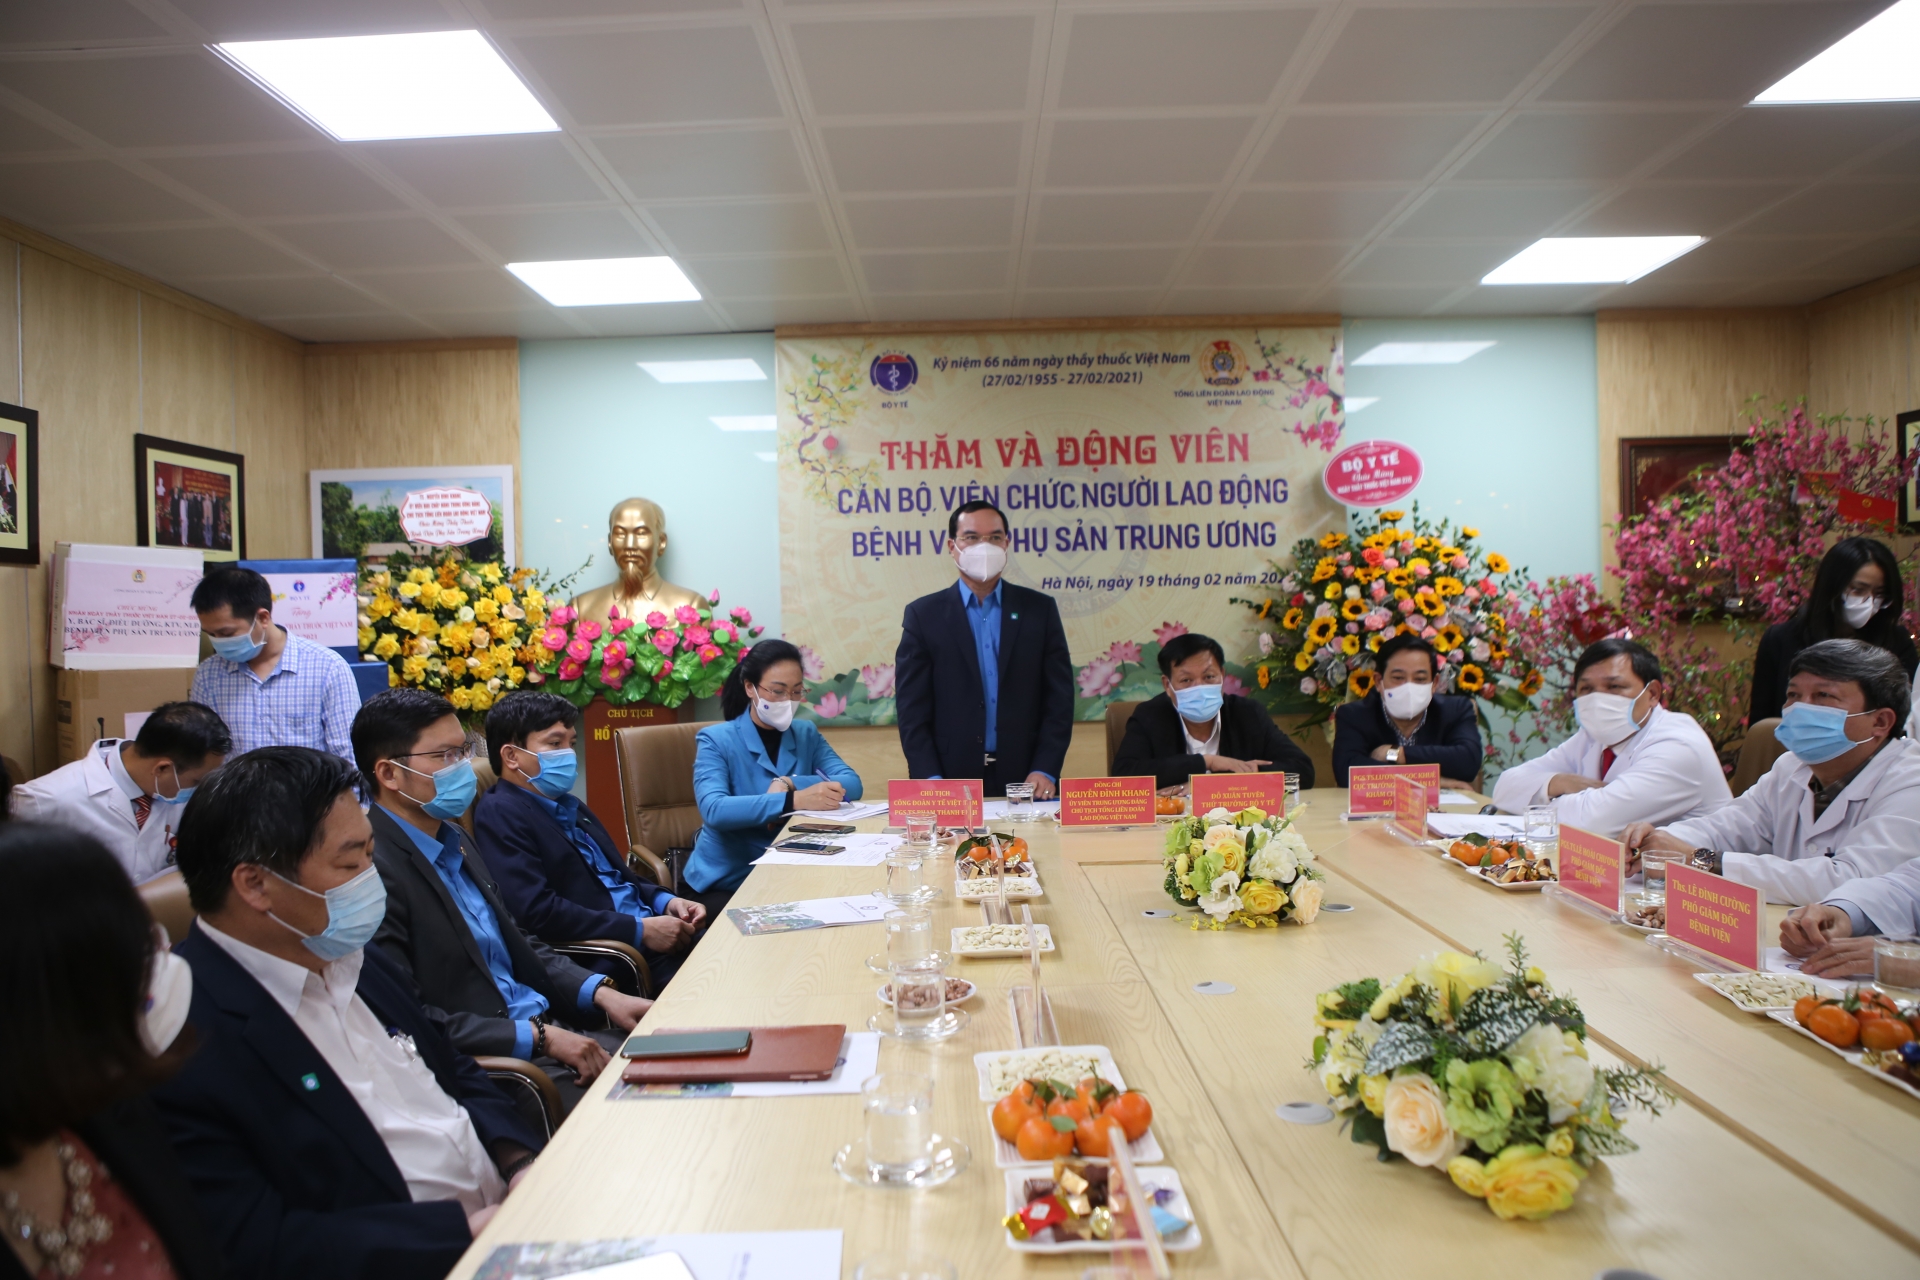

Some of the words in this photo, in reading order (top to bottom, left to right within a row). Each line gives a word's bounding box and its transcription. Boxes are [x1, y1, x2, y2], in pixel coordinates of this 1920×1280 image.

[933, 356, 948, 372] Kỷ
[951, 356, 981, 371] niệm
[984, 356, 1000, 368] 66
[1002, 355, 1030, 368] năm
[1032, 354, 1063, 370] ngày
[1097, 351, 1132, 366] thuốc
[1135, 352, 1159, 367] Việt
[1161, 352, 1191, 364] Nam
[982, 373, 1058, 388] (27/02/1955
[1067, 371, 1143, 386] 27/02/2021)
[1196, 389, 1212, 397] LIÊN
[1213, 388, 1235, 397] ĐOÀN
[1252, 388, 1275, 397] ĐỘNG
[881, 400, 892, 409] BỘ
[899, 400, 908, 408] TẾ
[1207, 399, 1223, 407] VIỆT
[880, 433, 983, 471] THĂM
[995, 430, 1044, 468] VÀ
[1056, 429, 1157, 473] ĐỘNG
[1170, 427, 1250, 464] VIÊN
[1341, 456, 1363, 473] BỘ
[1366, 455, 1377, 469] Y
[1380, 449, 1400, 467] TẾ
[838, 483, 891, 514] CÁN
[898, 481, 937, 517] BỘ,
[939, 480, 999, 511] VIÊN
[1006, 478, 1080, 510] CHỨC,
[1082, 475, 1159, 509] NGƯỜI
[1165, 480, 1213, 506] LAO
[1219, 474, 1289, 509] ĐỘNG
[852, 526, 922, 561] BỆNH
[1055, 519, 1107, 552] SẢN
[1115, 523, 1200, 551] TRUNG
[1207, 520, 1277, 548] ƯƠNG
[1041, 576, 1062, 590] Hà
[1065, 576, 1094, 593] Nội,
[1097, 574, 1134, 592] ngày
[1138, 575, 1155, 588] 19
[1158, 573, 1200, 589] tháng
[1204, 573, 1221, 586] 02
[1224, 572, 1256, 585] năm
[1259, 571, 1285, 585] 202
[77, 617, 96, 625] BÁC
[112, 628, 128, 637] PHỤ
[149, 629, 177, 637] TRUNG
[607, 706, 627, 718] CHỦ
[630, 708, 654, 719] TỊCH
[594, 724, 610, 740] HỒ
[1353, 783, 1366, 791] CỤC
[1066, 788, 1099, 799] NGUYỄN
[1100, 788, 1120, 798] ĐÌNH
[1121, 789, 1150, 797] KHANG
[1222, 791, 1241, 799] XUÂN
[1366, 790, 1386, 798] KHÁM
[937, 798, 946, 806] TẾ
[947, 799, 962, 807] VIỆT
[1218, 799, 1248, 807] TRƯỞNG
[1249, 799, 1259, 807] BỘ
[1266, 797, 1276, 806] TẾ
[1383, 798, 1393, 806] BỘ
[937, 808, 960, 816] THANH
[1092, 814, 1109, 822] ĐỘNG
[1109, 813, 1124, 821] VIỆT
[1570, 855, 1582, 867] PHÓ
[1582, 859, 1595, 873] GIÁM
[1595, 864, 1607, 877] ĐỐC
[1575, 869, 1589, 883] BỆNH
[1589, 874, 1602, 889] VIỆN
[1672, 879, 1687, 893] Ths.
[1688, 883, 1697, 897] LÊ
[1698, 886, 1718, 904] ĐÌNH
[1719, 896, 1751, 915] CƯỜNG
[1682, 899, 1698, 914] PHÓ
[1699, 905, 1720, 922] GIÁM
[1721, 913, 1739, 929] ĐỐC
[1689, 918, 1710, 936] BỆNH
[1711, 927, 1731, 944] VIỆN
